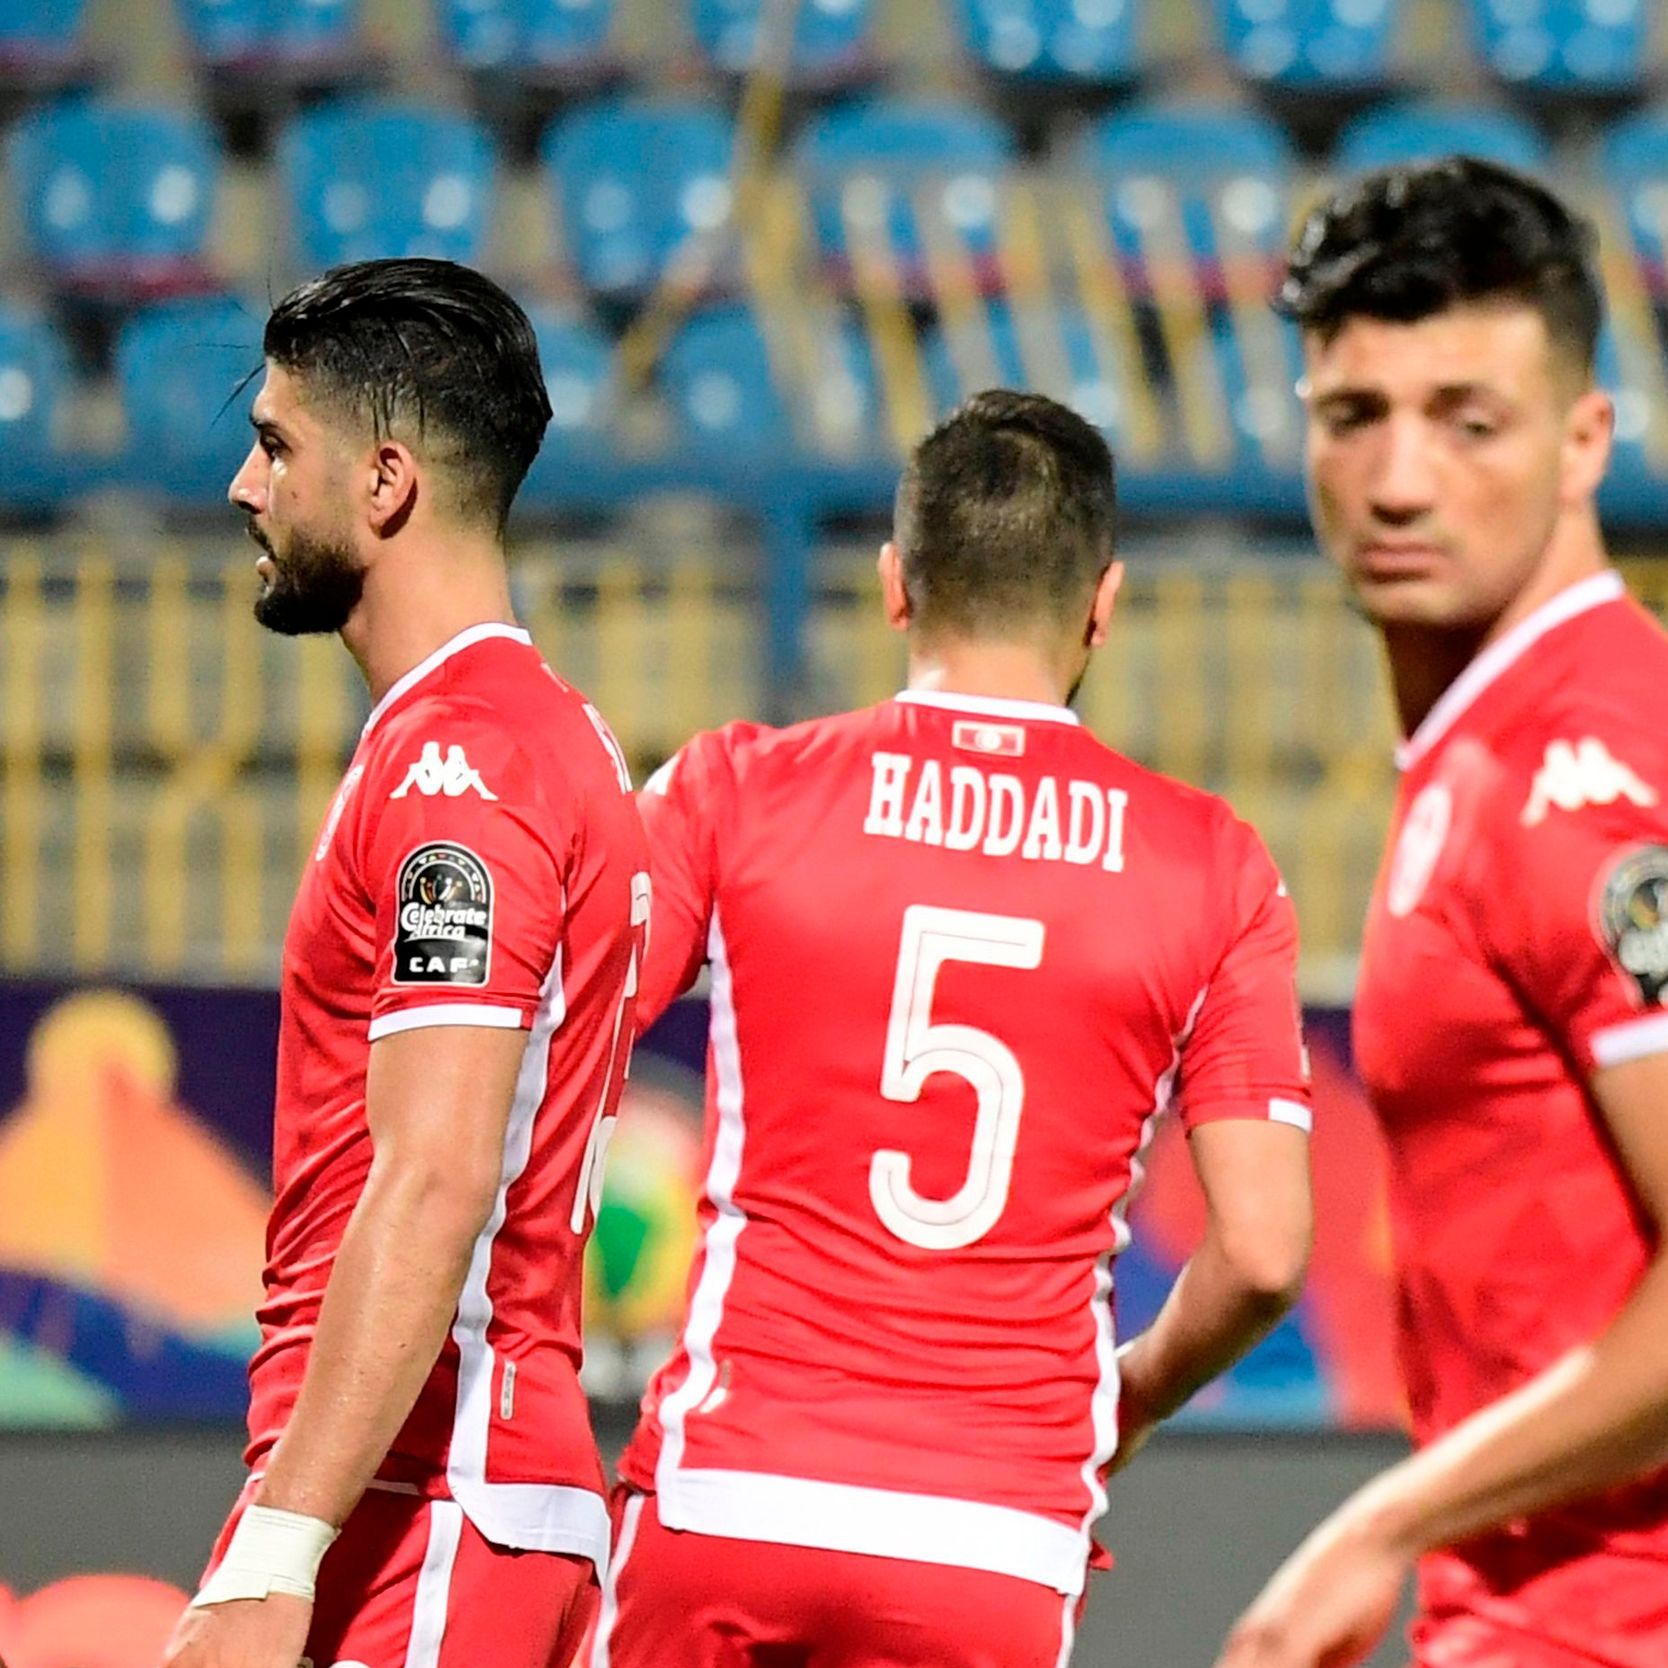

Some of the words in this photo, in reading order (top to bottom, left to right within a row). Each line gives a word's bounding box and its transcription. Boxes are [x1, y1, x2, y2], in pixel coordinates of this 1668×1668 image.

[863, 751, 1128, 873] HADDADI
[401, 902, 487, 932] Celebrate
[409, 956, 468, 973] CAF
[868, 903, 1045, 1251] 5
